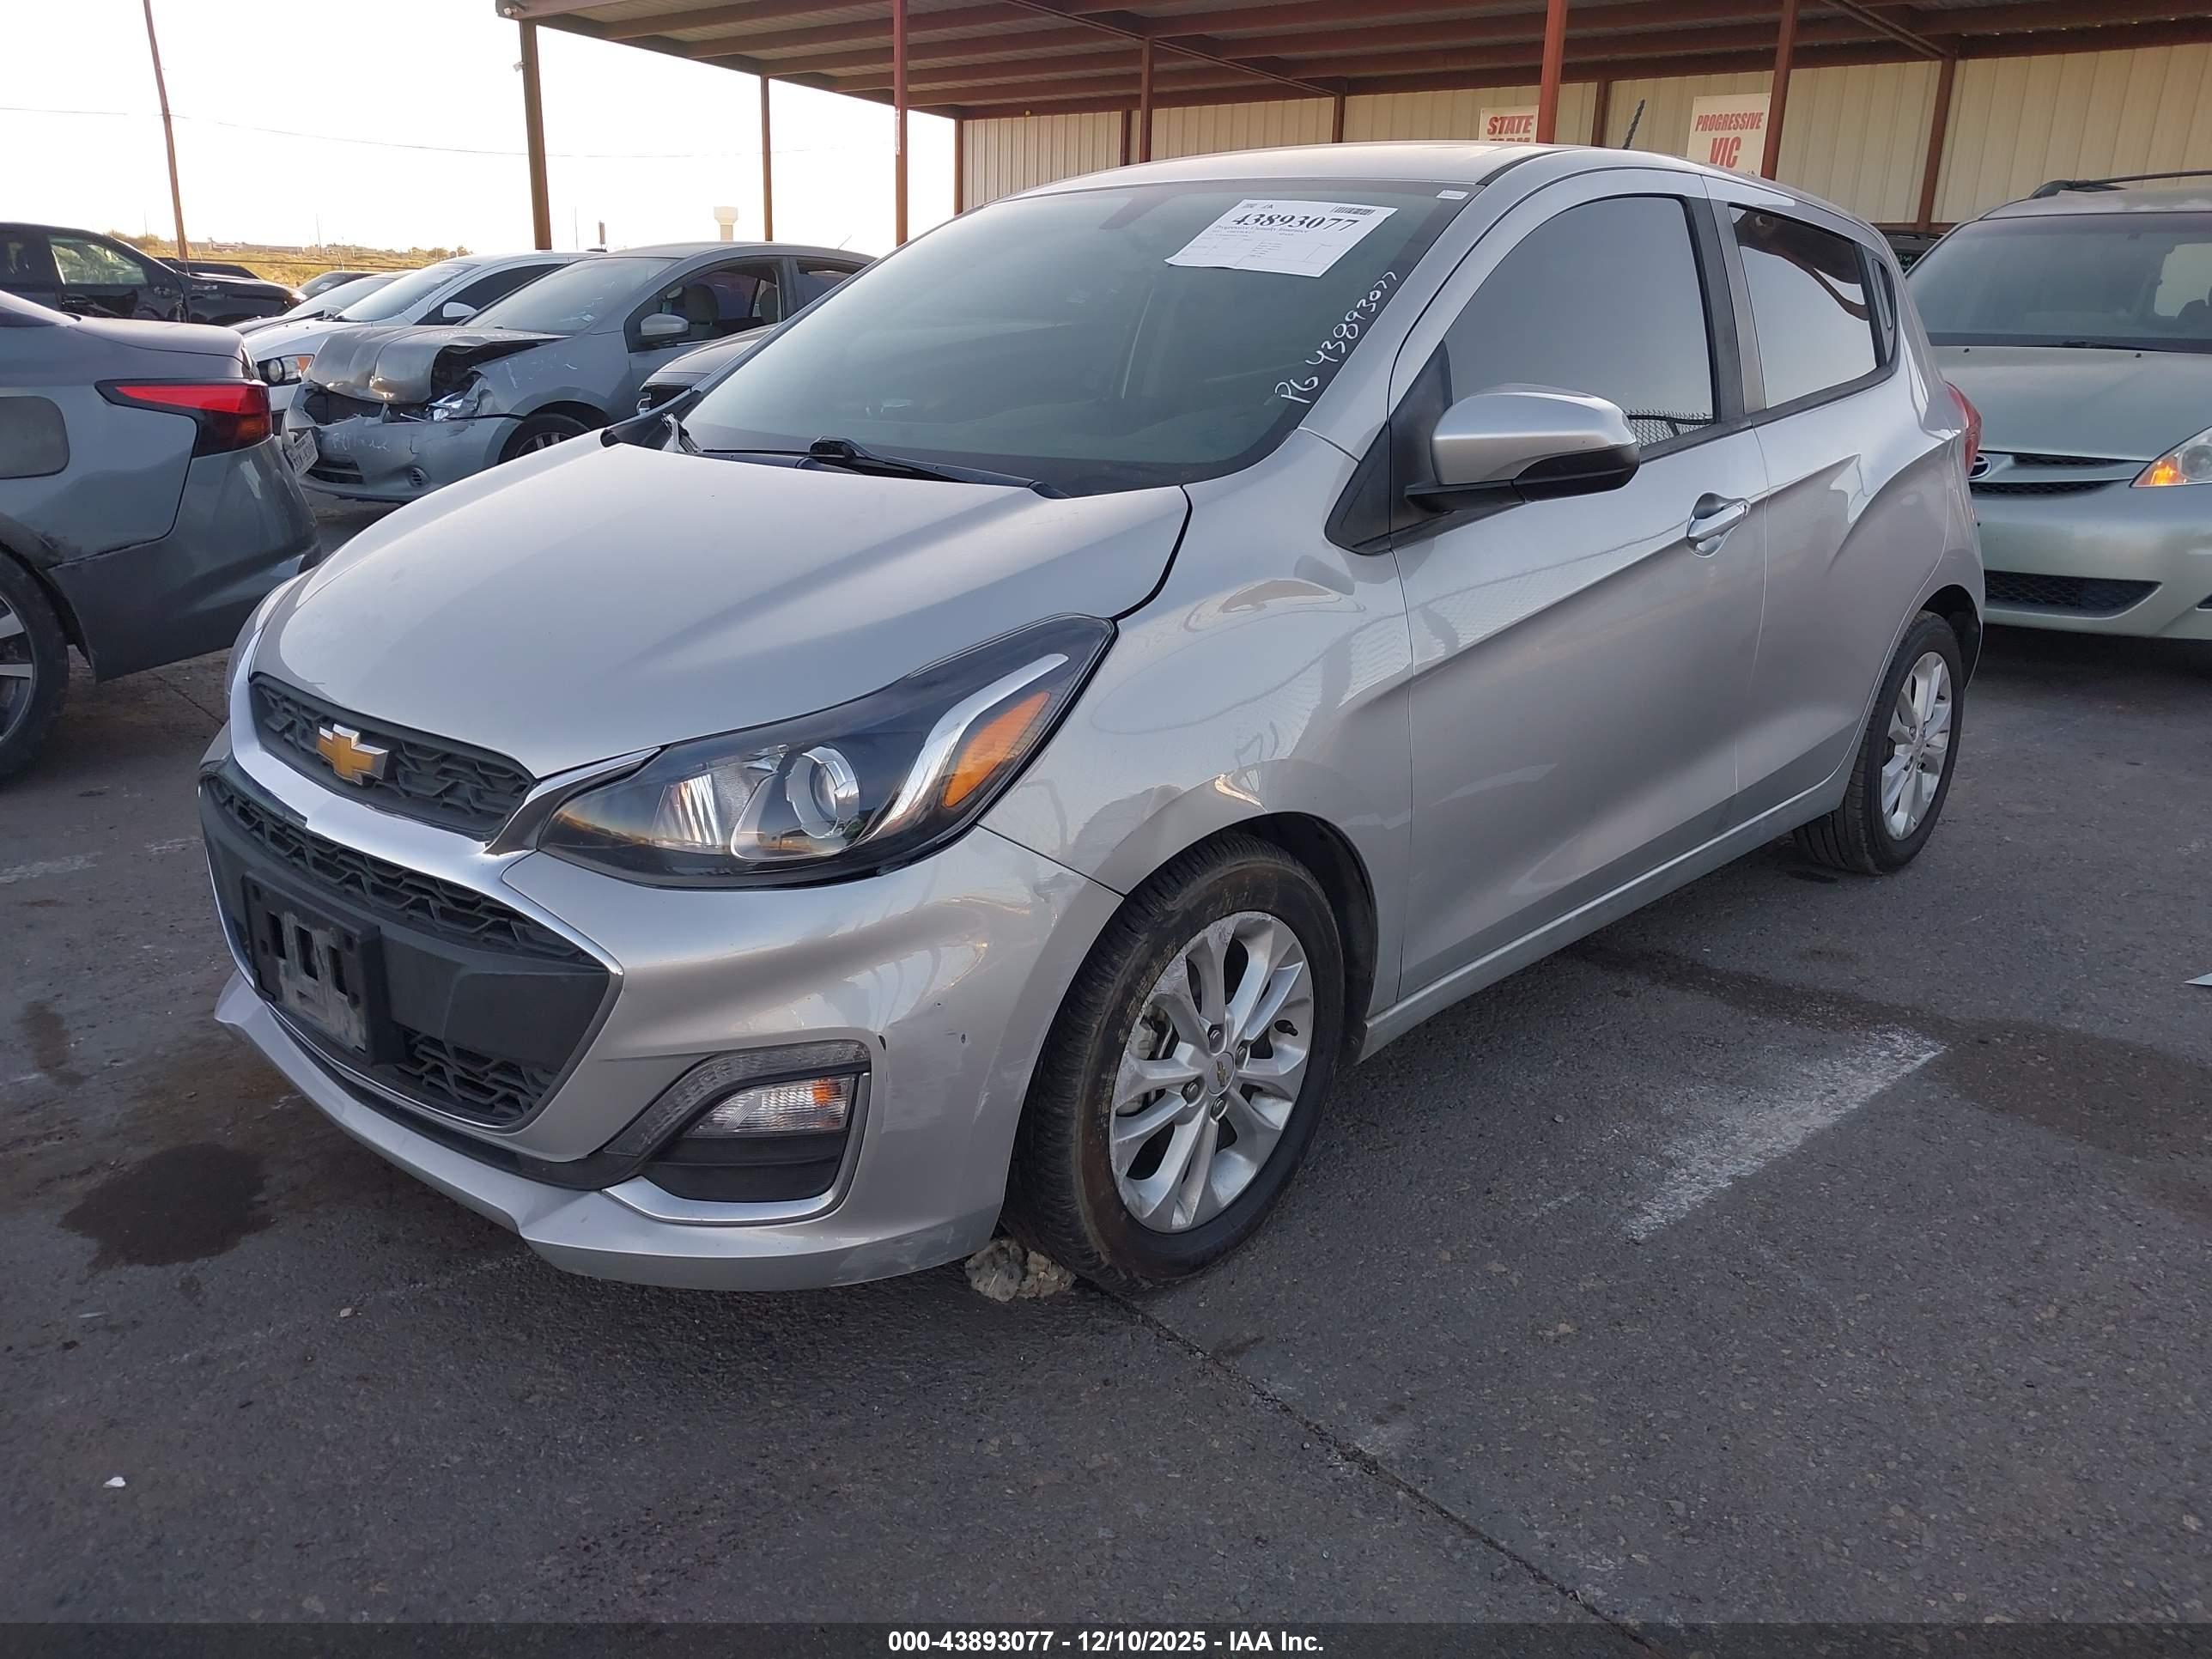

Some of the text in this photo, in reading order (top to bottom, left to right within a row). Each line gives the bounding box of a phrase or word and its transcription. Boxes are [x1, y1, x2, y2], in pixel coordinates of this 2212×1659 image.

[1487, 115, 1534, 135] STATE
[1695, 112, 1764, 132] PROGRESSIVE
[1710, 137, 1741, 168] VIC
[1232, 213, 1360, 232] 43893077
[1305, 271, 1397, 365] 43893077
